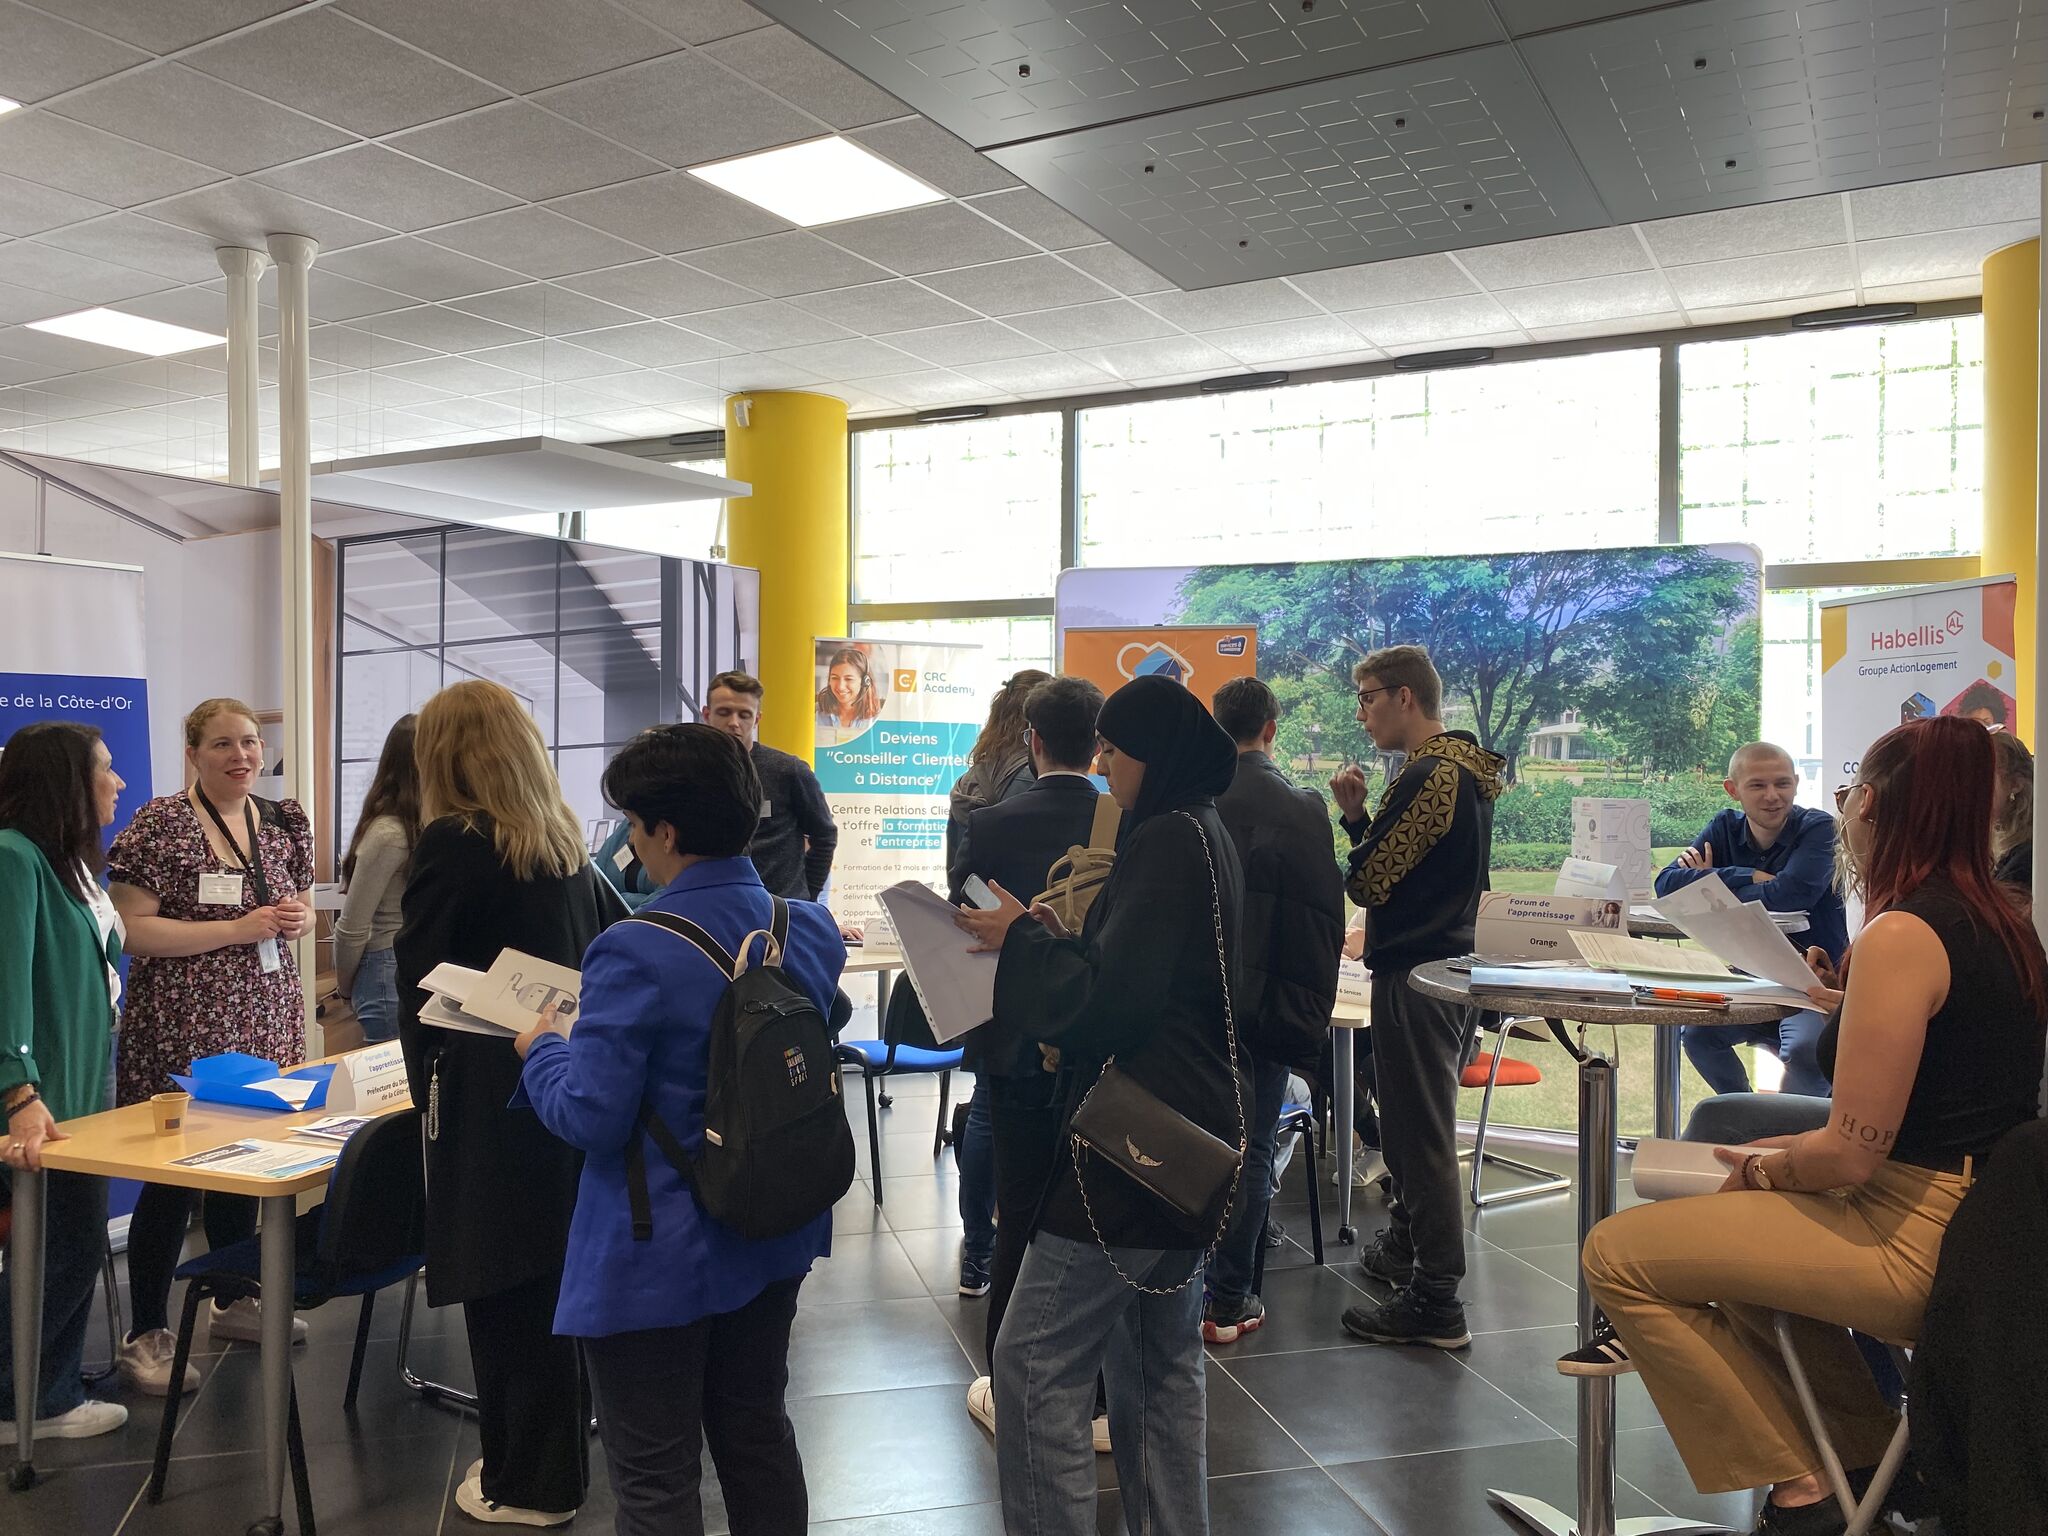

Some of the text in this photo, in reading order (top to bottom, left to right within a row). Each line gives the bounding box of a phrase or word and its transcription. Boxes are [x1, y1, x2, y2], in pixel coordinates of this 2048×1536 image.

[1871, 625, 1944, 650] Habellis
[1858, 660, 1957, 677] Groupe ActionLogement
[924, 672, 946, 682] CRC
[924, 684, 975, 697] Academy
[14, 693, 34, 708] de
[40, 694, 53, 708] la
[880, 731, 938, 745] Deviens
[826, 751, 907, 765] "Conseiller
[855, 772, 940, 786] à Distance"
[832, 805, 871, 815] Centre
[874, 805, 927, 815] Relations
[843, 820, 879, 830] t'offre
[883, 821, 894, 831] la
[860, 835, 940, 848] et l'entreprise
[843, 864, 881, 872] Formation
[1510, 898, 1550, 907] Forum de
[1508, 908, 1576, 920] l'apprentissage
[1530, 938, 1558, 948] Orange
